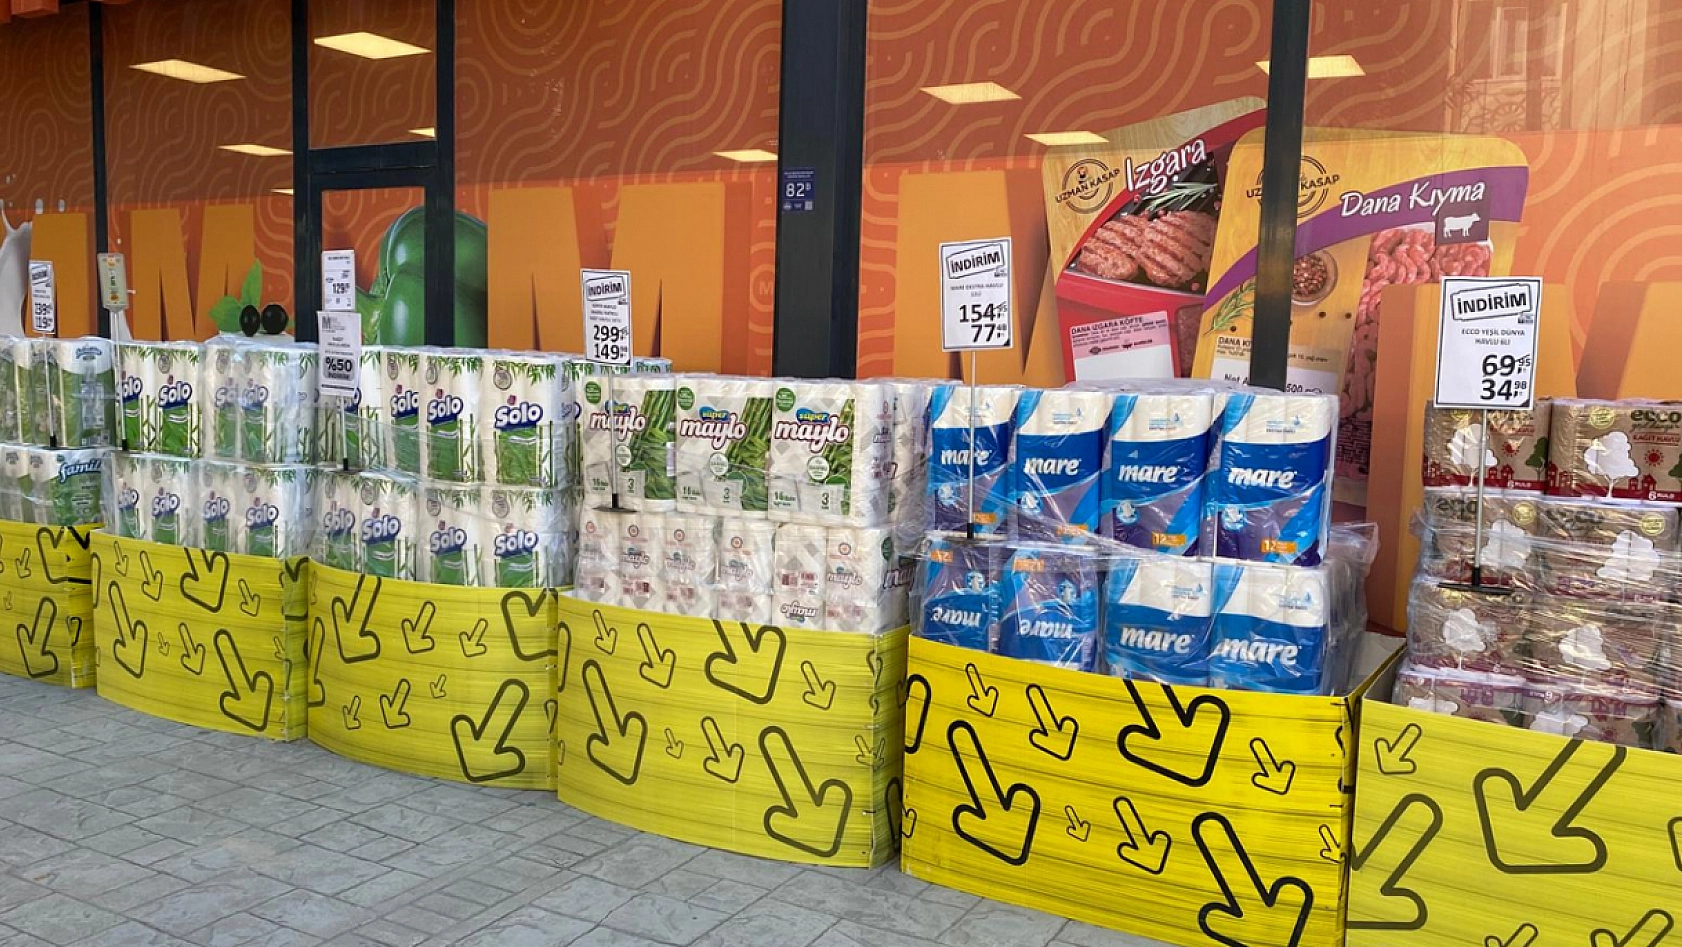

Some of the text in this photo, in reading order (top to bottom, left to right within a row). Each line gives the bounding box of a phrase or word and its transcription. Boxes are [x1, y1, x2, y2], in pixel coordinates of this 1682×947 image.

[1125, 138, 1207, 194] Izgara
[1054, 167, 1121, 204] UZMAN KASAP
[1340, 180, 1487, 217] Dana Kıyma
[950, 250, 1001, 274] İNDİRİM
[588, 281, 623, 296] İNDİRİM
[1457, 292, 1528, 315] İNDİRİM
[1071, 325, 1092, 335] DANA
[325, 356, 353, 372] %50
[680, 412, 747, 450] maylo
[775, 414, 849, 454] maylo
[1023, 456, 1079, 476] mare
[1118, 464, 1177, 484] mare
[1227, 466, 1295, 490] mare
[1019, 619, 1074, 640] mare
[1119, 626, 1192, 654] mare
[1220, 637, 1299, 666] mare
